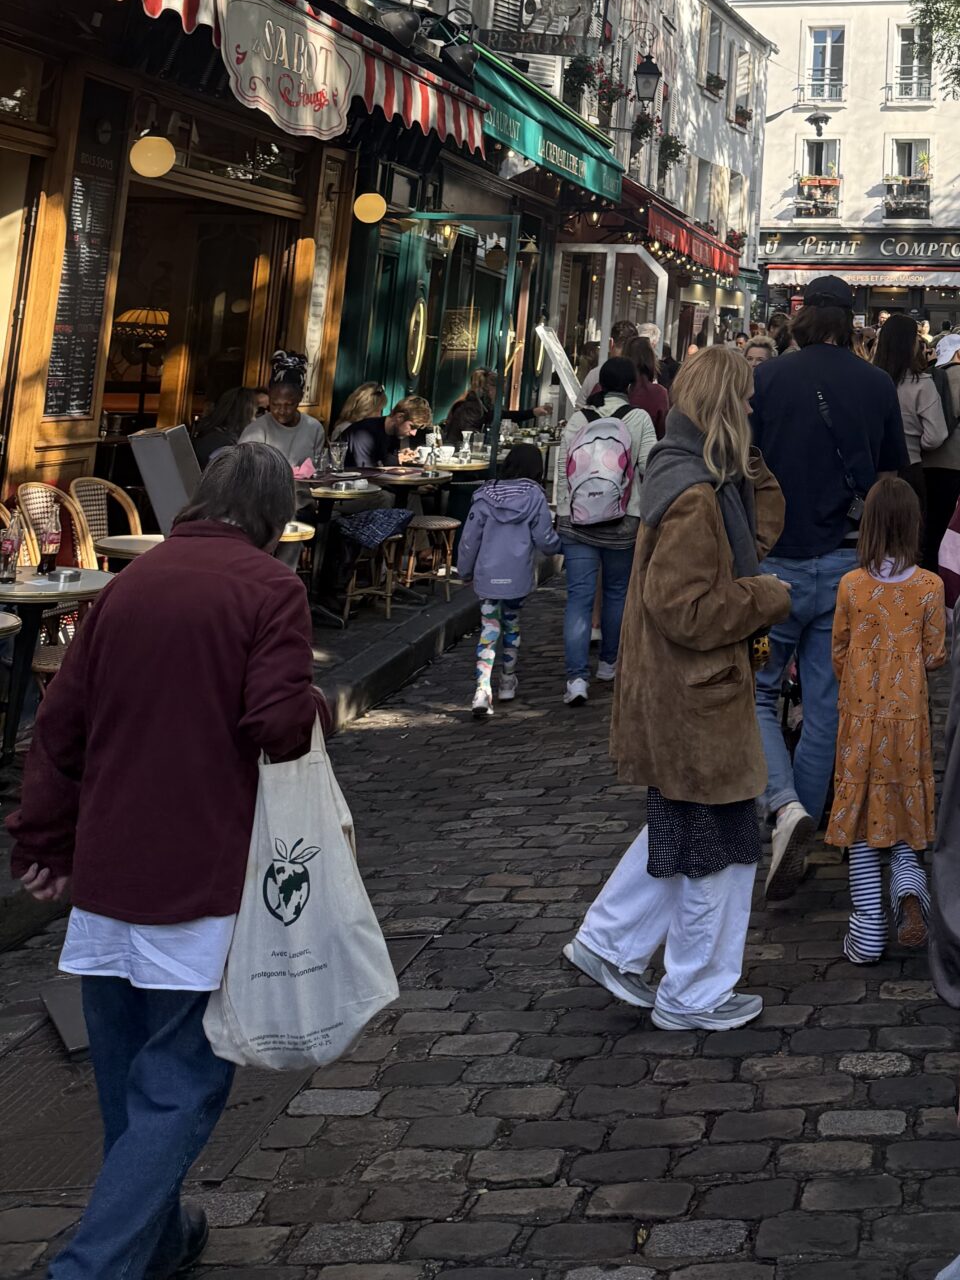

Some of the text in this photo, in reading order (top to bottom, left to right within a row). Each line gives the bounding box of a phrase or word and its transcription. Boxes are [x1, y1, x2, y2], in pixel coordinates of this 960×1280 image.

[263, 18, 332, 86] SABOT
[797, 235, 861, 255] PETIT
[899, 274, 925, 283] MAISON
[271, 950, 288, 958] Avec
